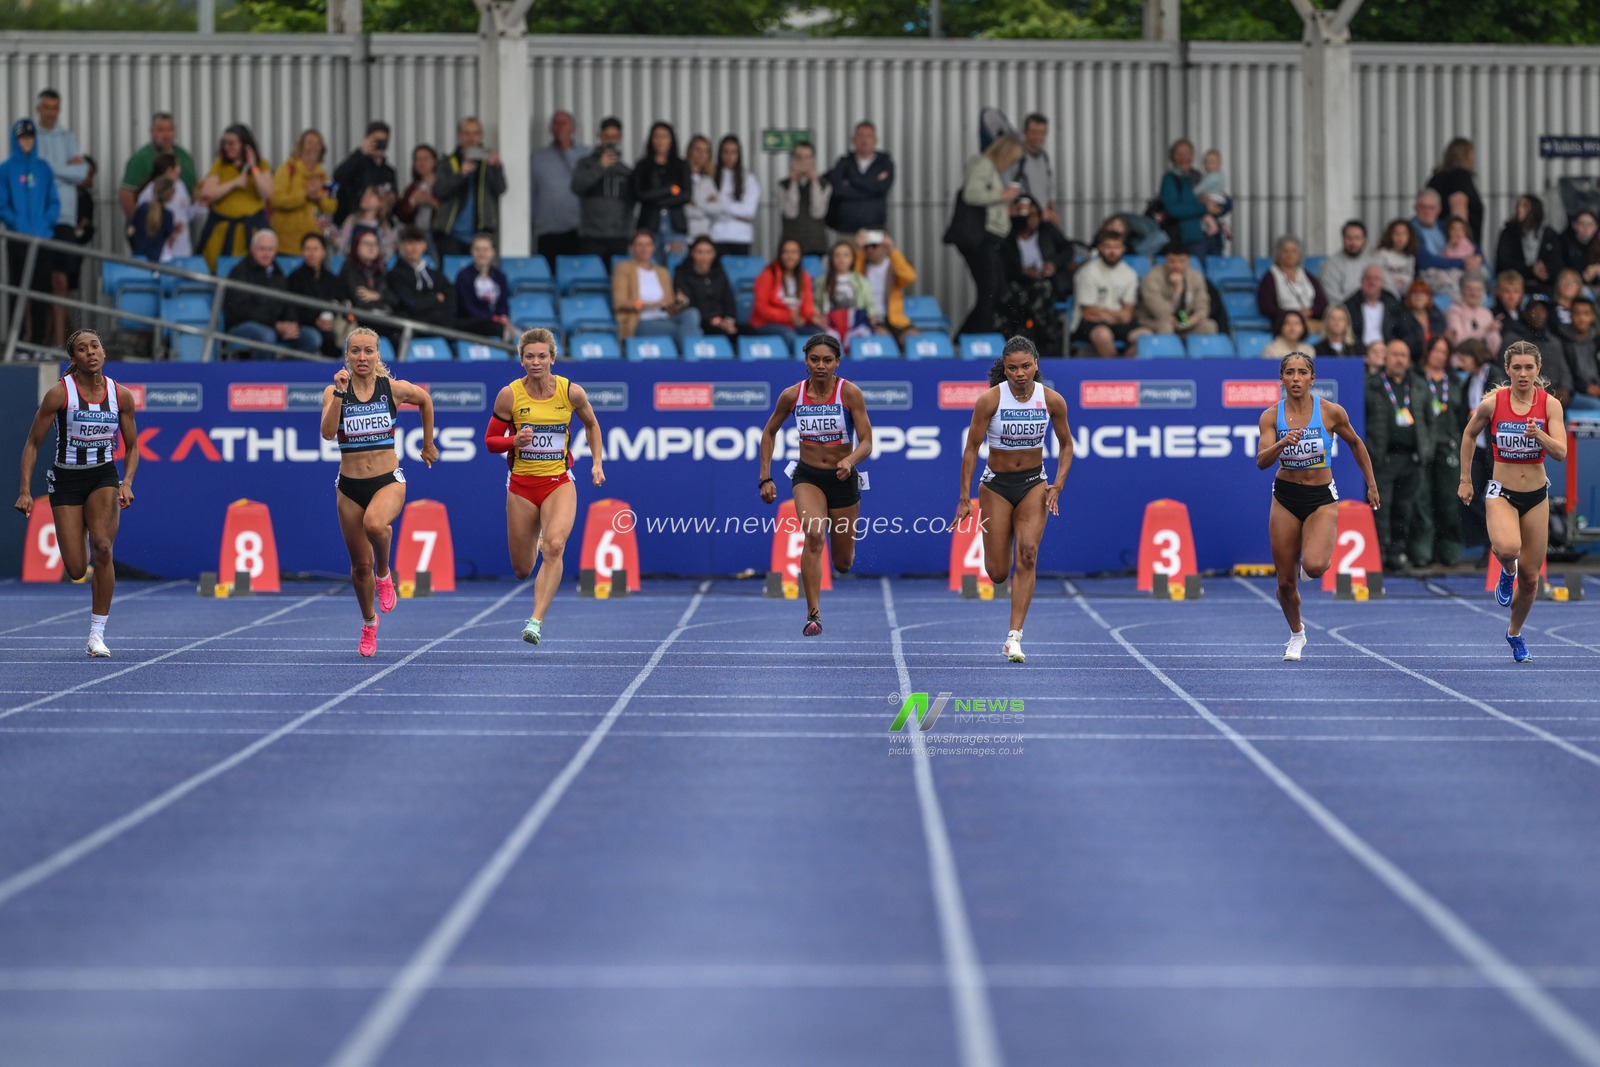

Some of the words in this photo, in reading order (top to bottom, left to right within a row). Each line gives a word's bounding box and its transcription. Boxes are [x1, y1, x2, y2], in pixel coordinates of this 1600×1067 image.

[80, 424, 110, 437] REGIS
[346, 415, 390, 432] KUYPERS
[800, 418, 837, 431] SLATER
[1002, 423, 1045, 436] MODESTE
[72, 439, 112, 448] MANCHESTER
[170, 427, 477, 462] ATHLEICS
[531, 435, 553, 448] COX
[1282, 441, 1318, 456] GRACE
[521, 452, 562, 460] MANCHESTER
[1284, 456, 1321, 468] MANCHESTER
[1500, 450, 1539, 459] MANCHESTER
[1488, 483, 1497, 496] 2
[38, 522, 61, 569] 9
[411, 531, 438, 572] 7
[594, 529, 624, 577] 6
[963, 530, 990, 577] 4
[1152, 529, 1182, 577] 3
[1337, 530, 1366, 577] 2
[235, 530, 263, 578] 8
[786, 531, 805, 578] 5
